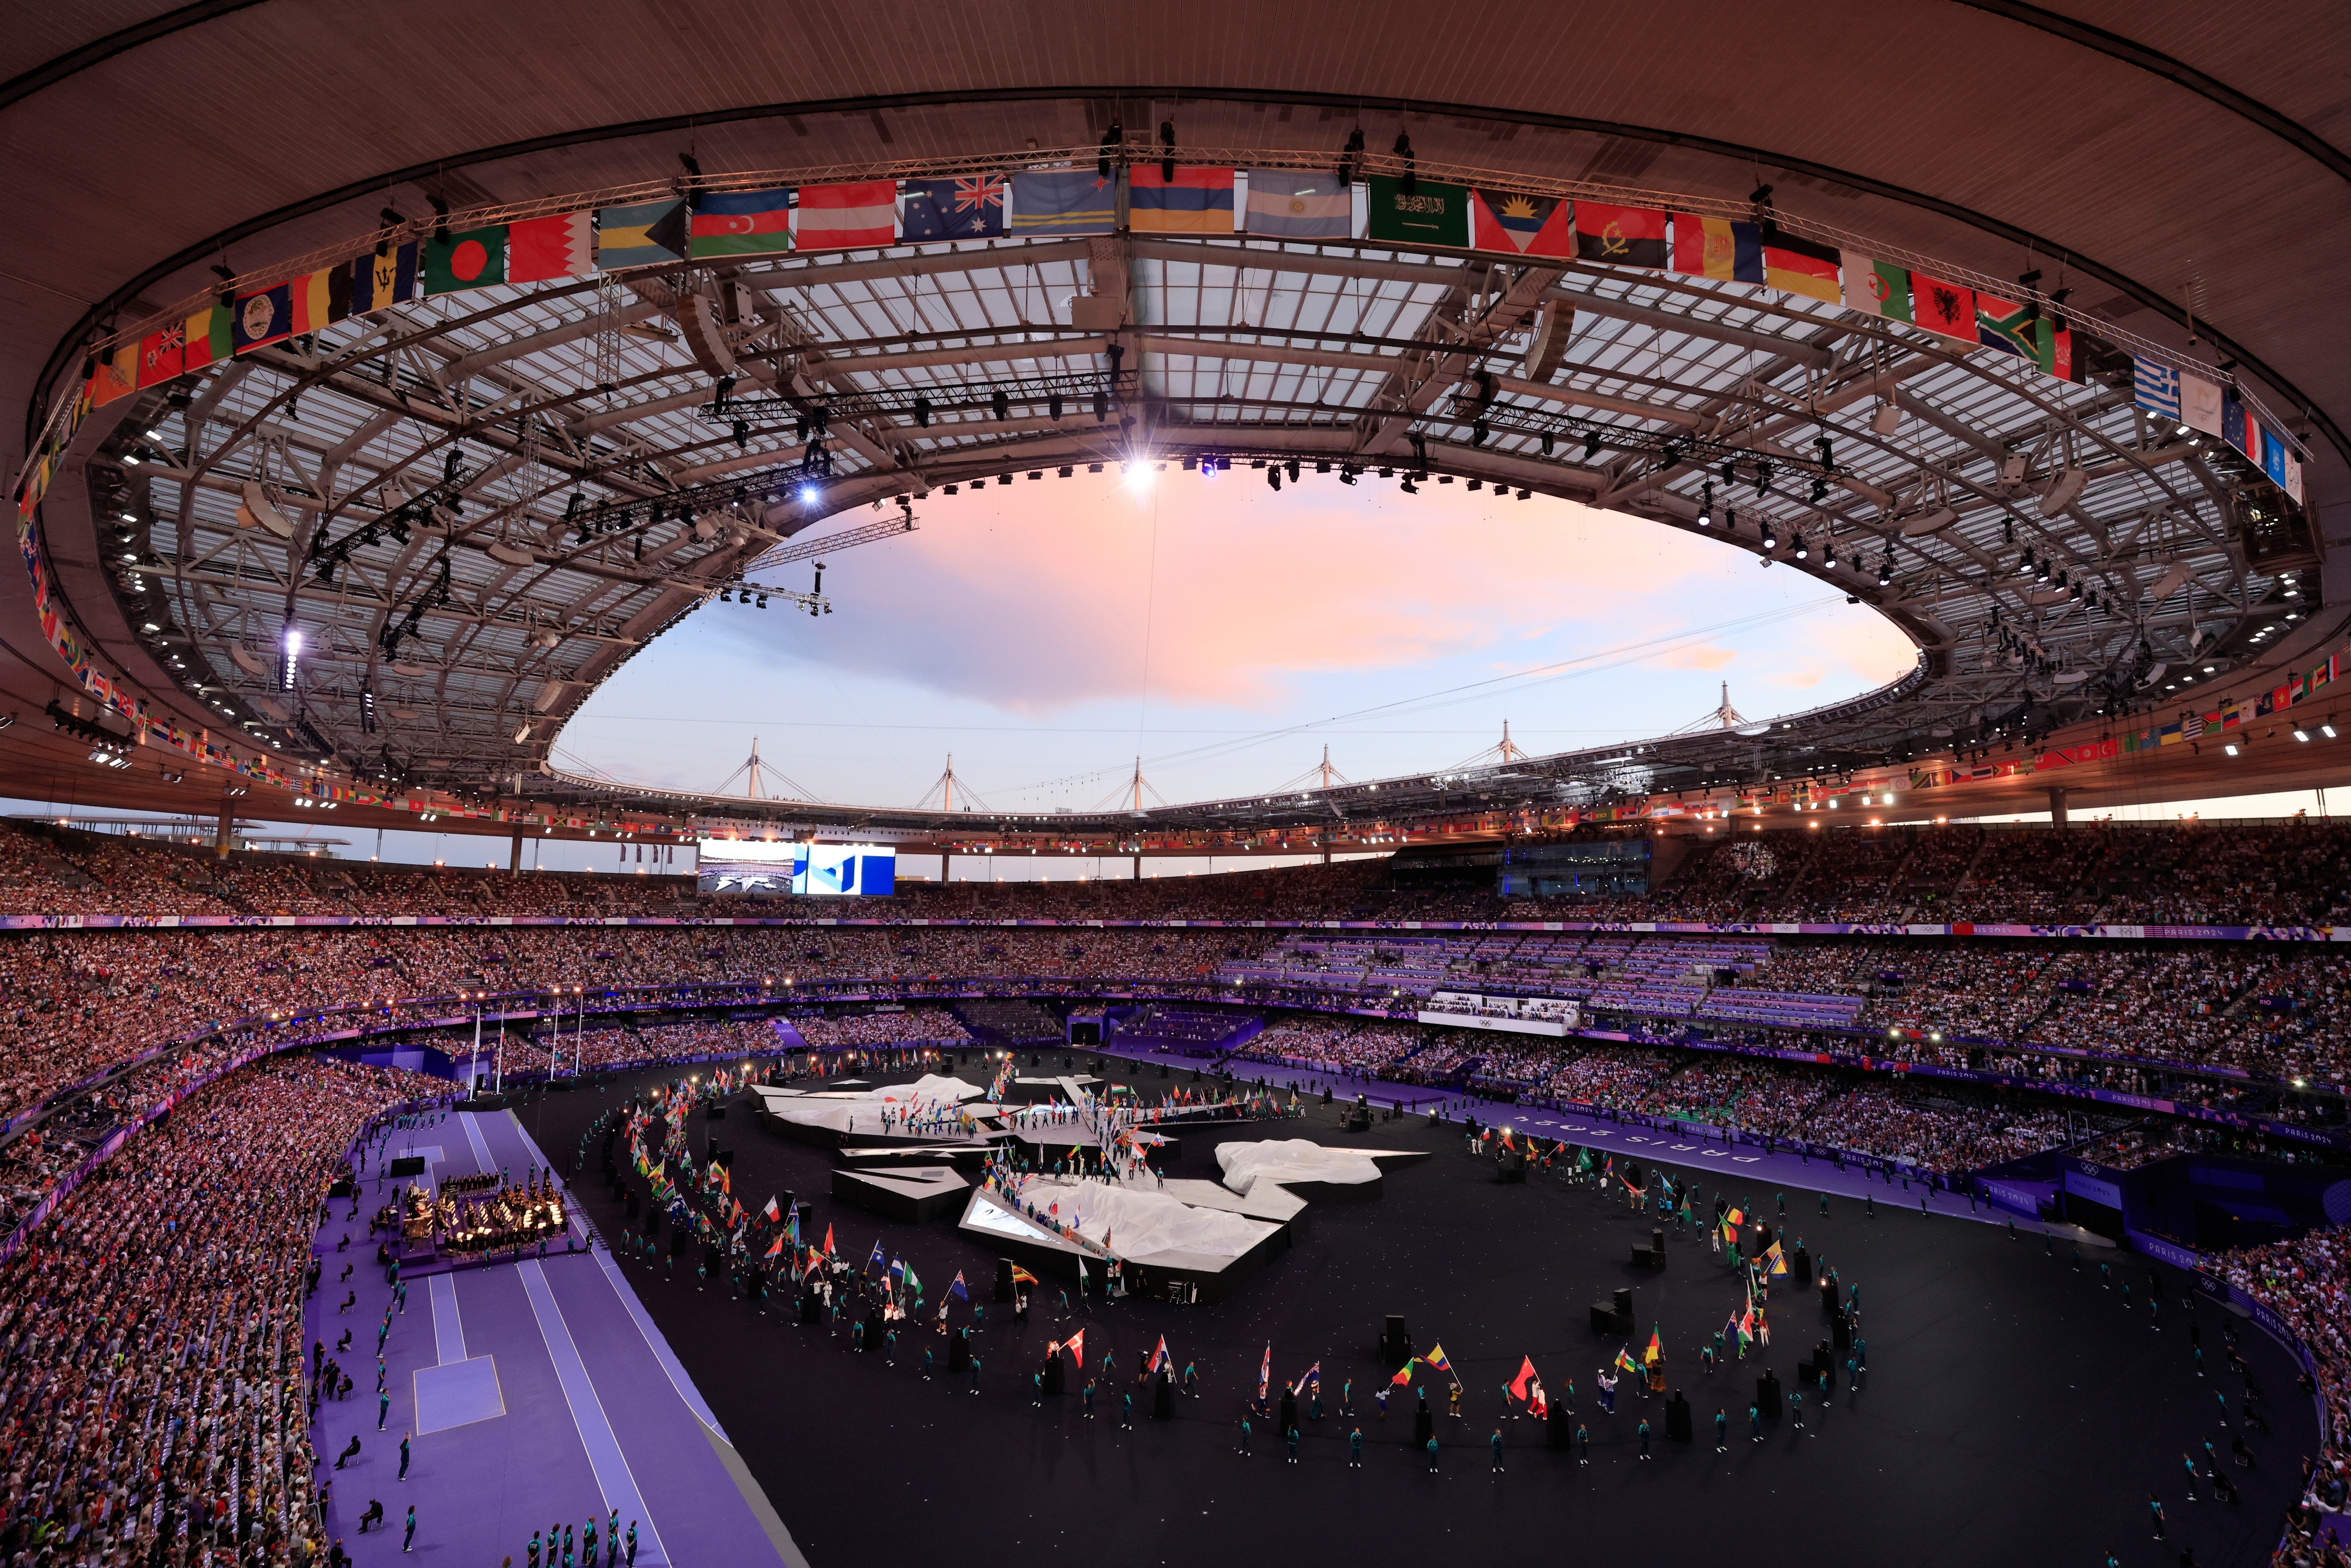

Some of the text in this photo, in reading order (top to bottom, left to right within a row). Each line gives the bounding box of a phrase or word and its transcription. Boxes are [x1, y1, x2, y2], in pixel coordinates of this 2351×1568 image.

[2112, 1095, 2134, 1103] PARIS
[1514, 1116, 1761, 1163] PARIS 2024
[2285, 1128, 2331, 1144] PARIS 2024
[1990, 1186, 2028, 1205] ARIS 2024
[2074, 1179, 2110, 1197] PARIS 2024
[2149, 1242, 2197, 1267] PARIS 20
[2256, 1307, 2293, 1344] PARIS 2024
